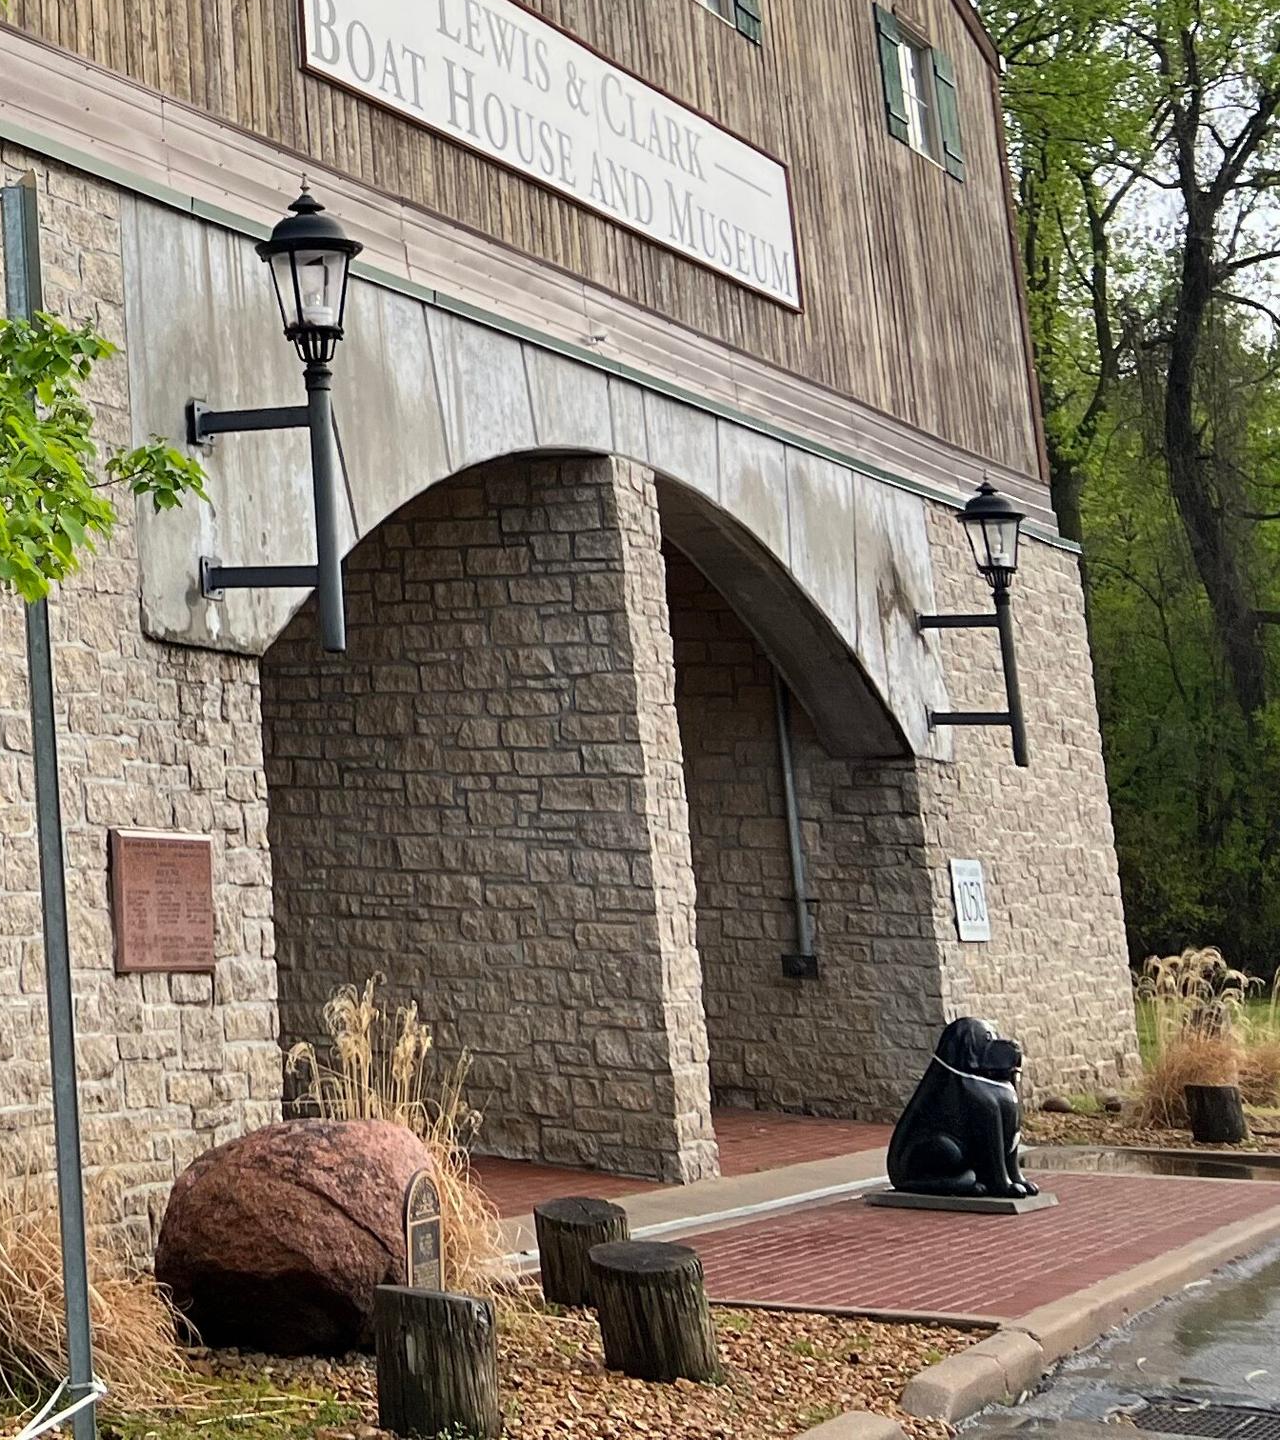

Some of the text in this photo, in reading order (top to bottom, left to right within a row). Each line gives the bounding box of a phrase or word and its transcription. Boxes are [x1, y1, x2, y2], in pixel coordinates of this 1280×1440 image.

[442, 55, 577, 192] HOUSE
[589, 151, 654, 227] AND
[664, 179, 793, 298] MUSEUM
[565, 60, 590, 117] &
[600, 72, 708, 183] CLARK
